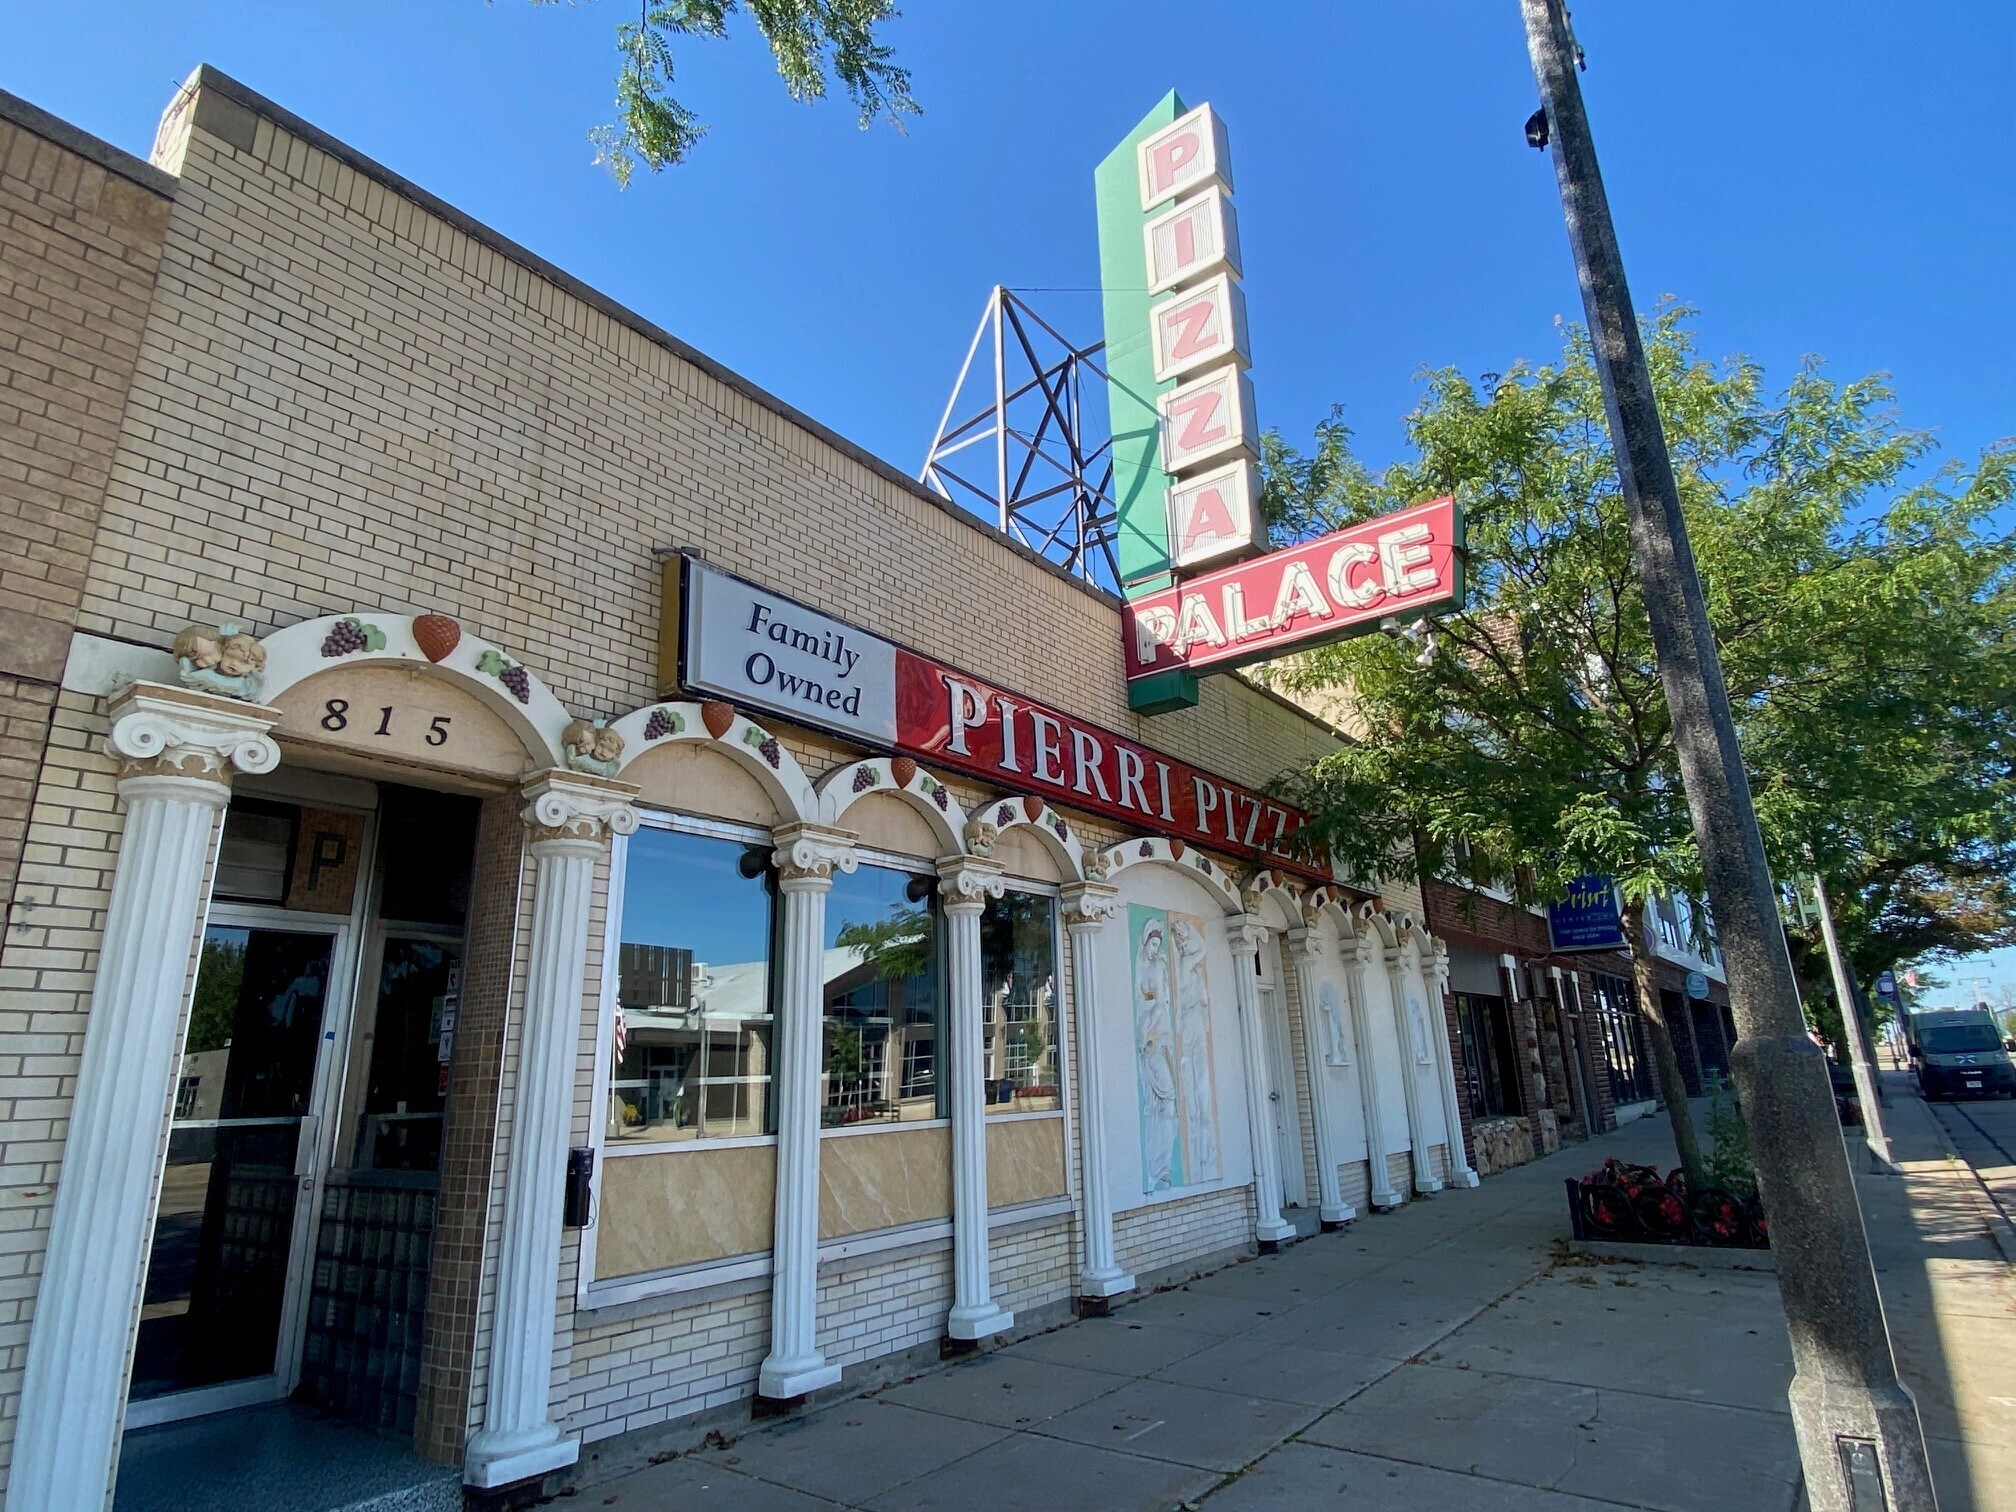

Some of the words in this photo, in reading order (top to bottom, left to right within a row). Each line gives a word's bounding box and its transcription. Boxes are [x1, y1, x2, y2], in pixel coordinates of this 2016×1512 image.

[1153, 131, 1237, 549] PIZZA
[1135, 523, 1440, 665] PALACE
[746, 601, 861, 678] Family
[320, 698, 452, 747] 815
[745, 652, 862, 717] Owned
[943, 675, 1175, 823] PIERRI
[307, 830, 348, 892] P
